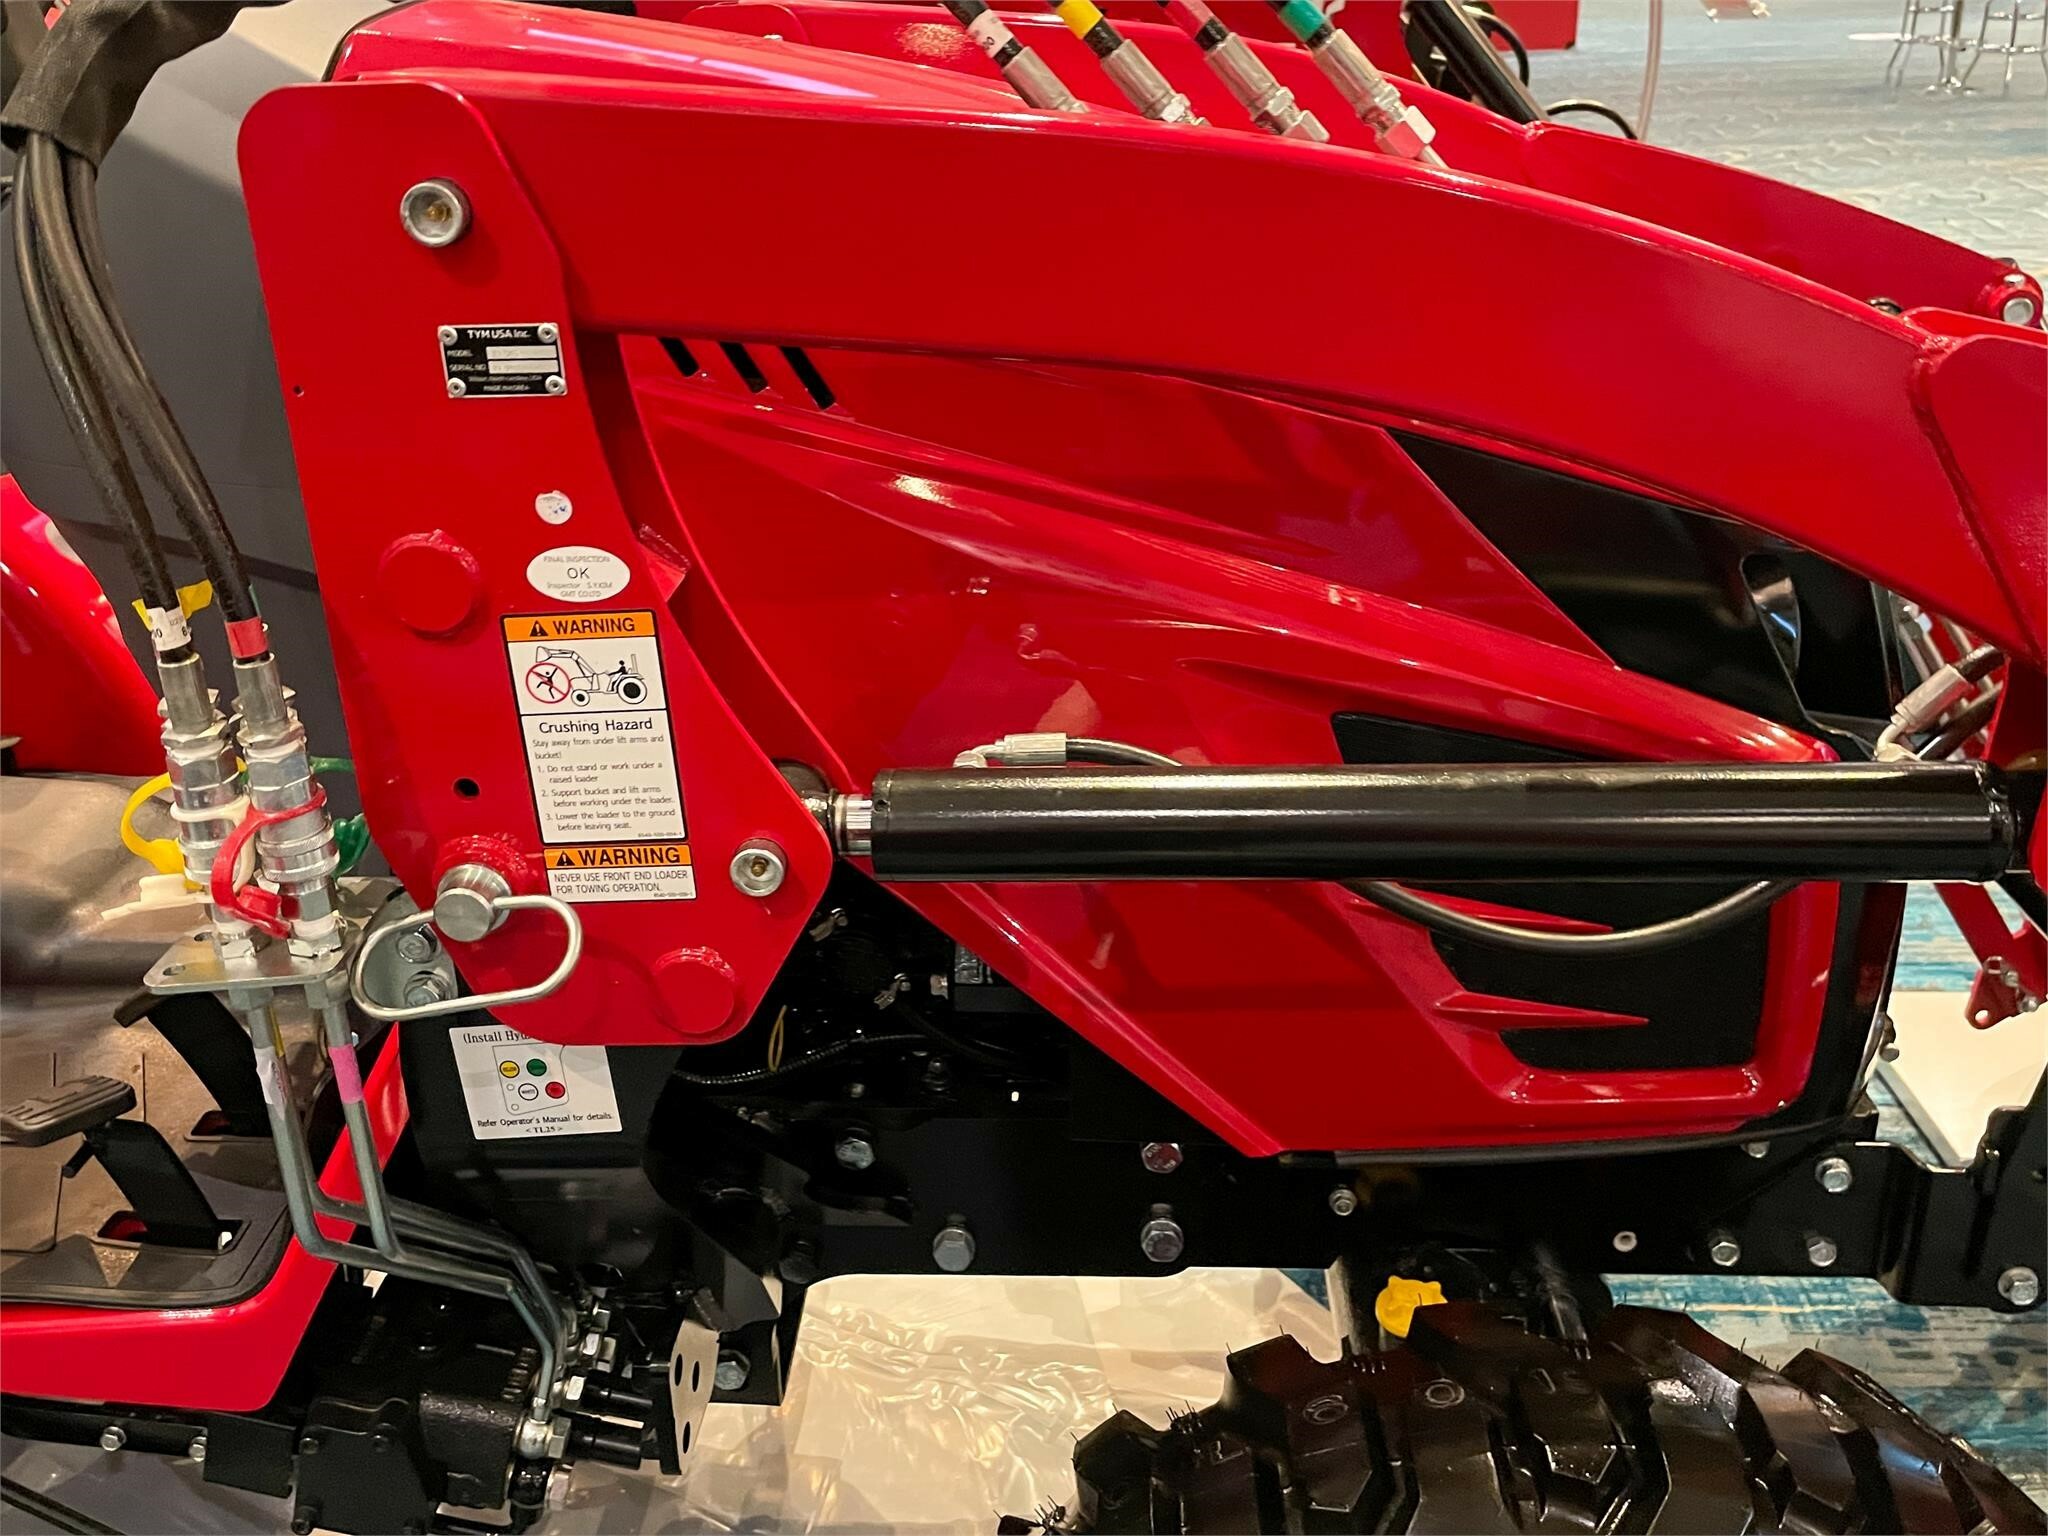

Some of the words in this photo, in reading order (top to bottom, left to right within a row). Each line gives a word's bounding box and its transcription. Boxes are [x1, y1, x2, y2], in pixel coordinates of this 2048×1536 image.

[467, 329, 490, 339] TYM
[491, 329, 512, 339] USA
[567, 568, 590, 579] OK
[553, 618, 635, 635] WARNING
[539, 721, 599, 735] Crushing
[605, 717, 653, 731] Hazard
[532, 739, 548, 748] Stay
[552, 739, 570, 747] away
[573, 737, 590, 745] from
[593, 737, 614, 745] under
[617, 736, 627, 744] lift
[651, 734, 664, 742] and
[561, 764, 574, 772] not
[577, 763, 597, 771] stand
[551, 789, 582, 798] Support
[579, 798, 609, 807] working
[649, 809, 676, 819] ground
[558, 823, 582, 831] before
[585, 822, 612, 831] leaving
[578, 847, 681, 866] WARNING
[554, 873, 581, 882] NEVER
[584, 872, 600, 881] USE
[603, 872, 630, 881] FRONT
[635, 871, 652, 880] END
[655, 870, 688, 879] LOADER
[557, 885, 573, 894] FOR
[577, 884, 610, 893] TOWING
[613, 883, 661, 892] OPERATION.
[463, 1031, 502, 1044] (Install
[477, 1119, 497, 1127] Refer
[500, 1117, 540, 1126] Operator's
[543, 1114, 570, 1124] Manual
